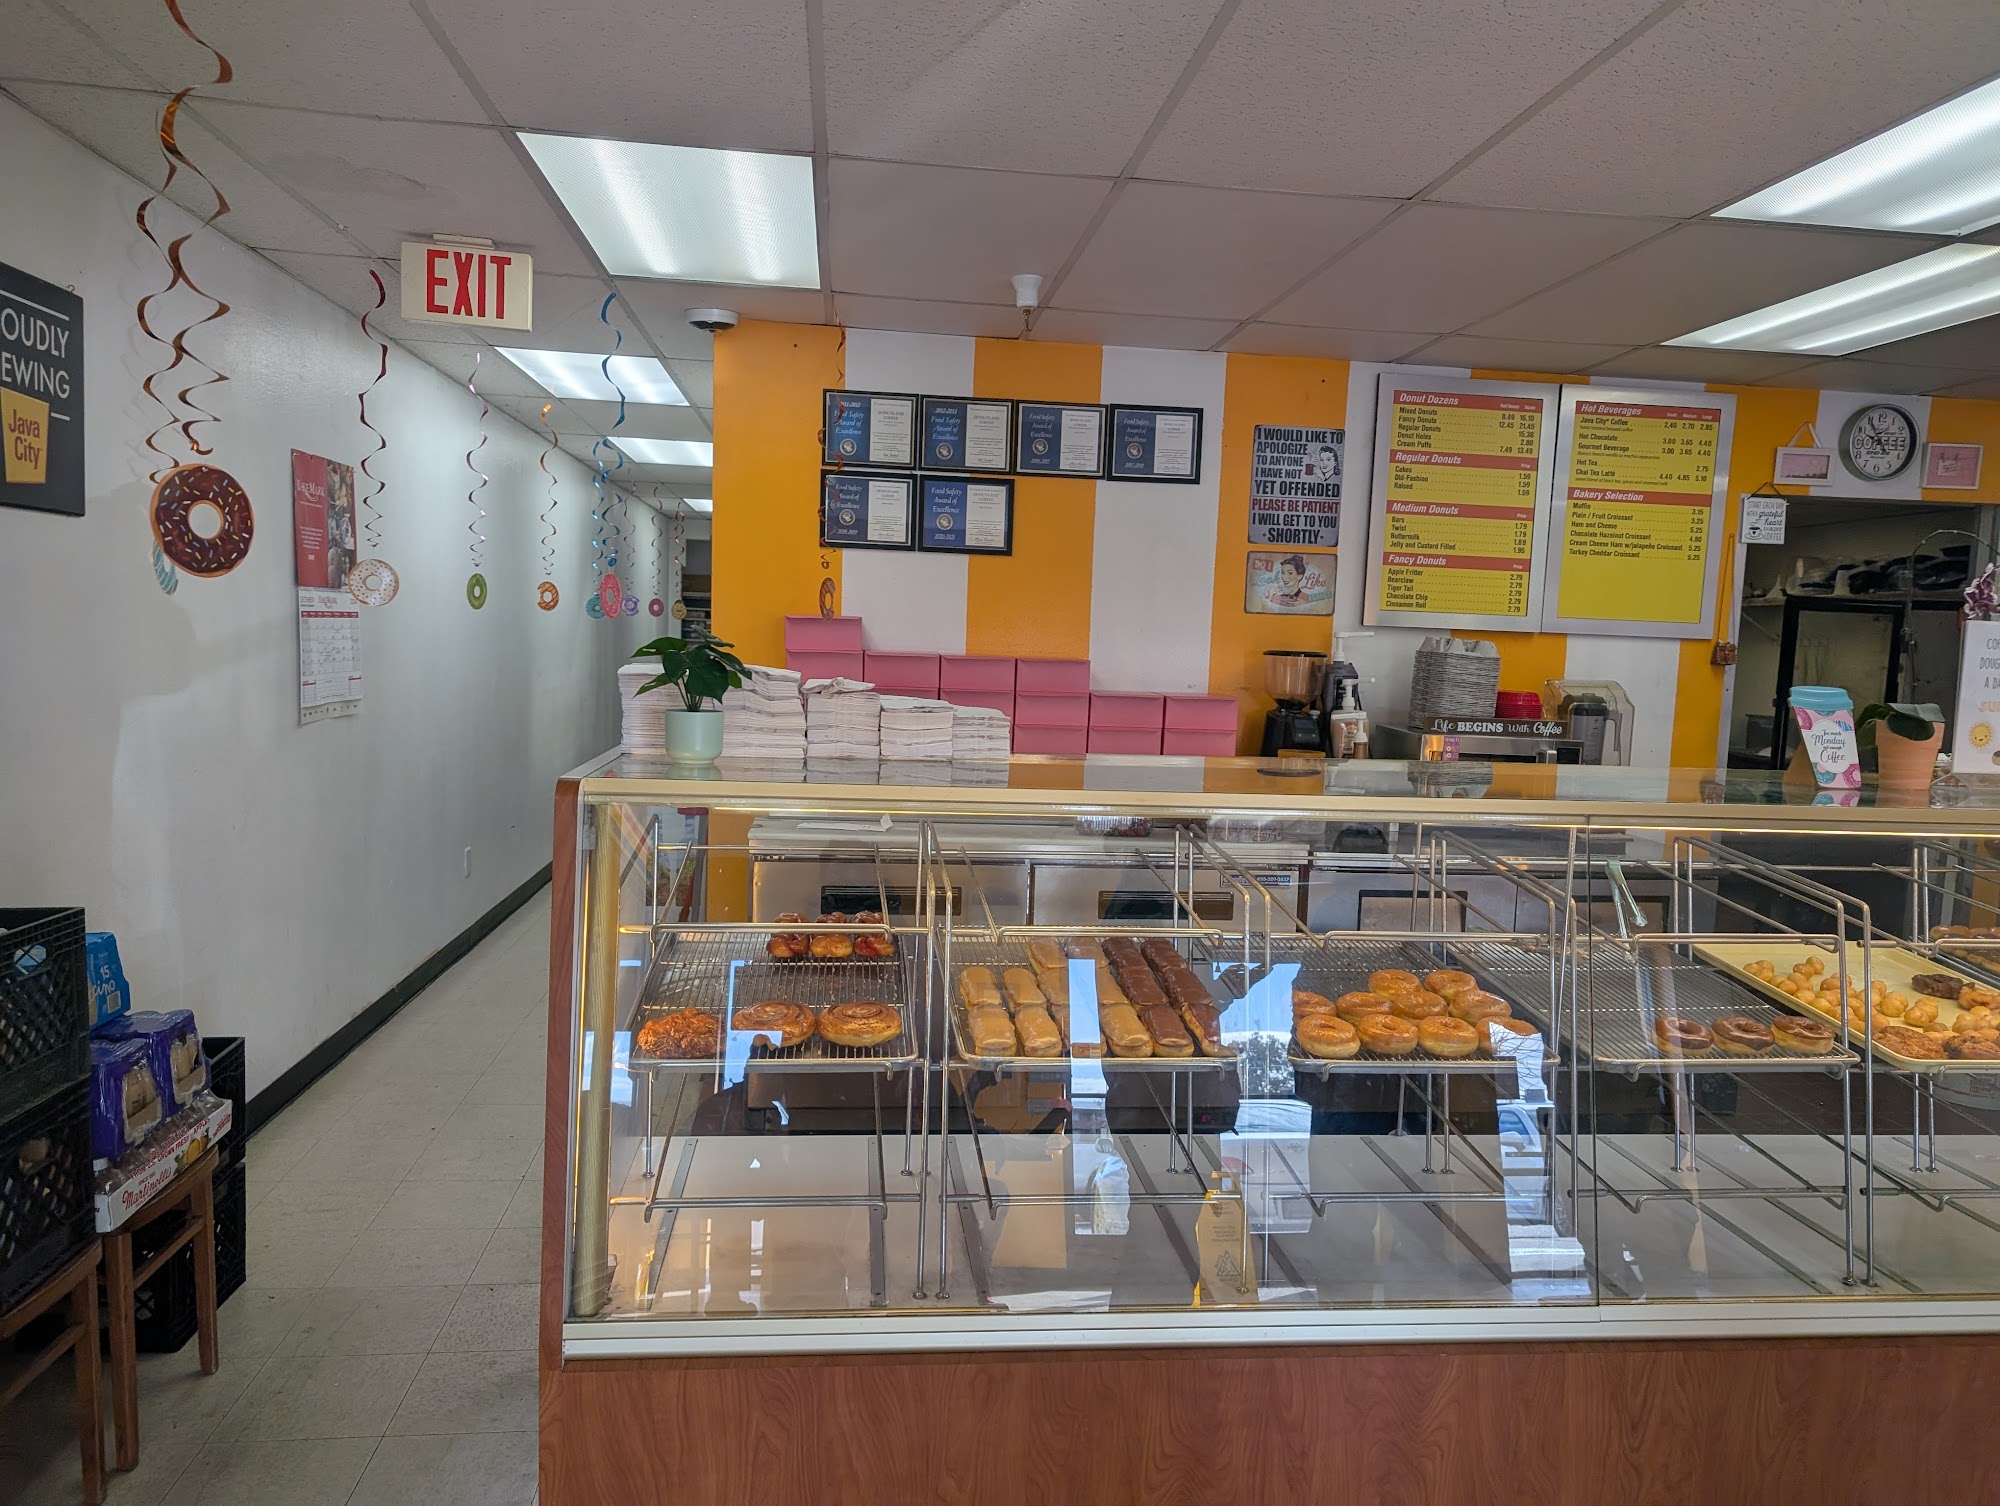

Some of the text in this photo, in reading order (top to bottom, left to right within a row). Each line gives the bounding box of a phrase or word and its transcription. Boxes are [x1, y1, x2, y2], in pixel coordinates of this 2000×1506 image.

[426, 249, 512, 320] EXIT
[1, 308, 69, 358] OUDLY
[2, 352, 70, 398] EWING
[1400, 393, 1459, 405] Donut Dozens
[1399, 407, 1416, 415] Mixed
[1581, 404, 1642, 416] Hot Beverages
[9, 409, 40, 438] Java
[1398, 424, 1420, 432] Regular
[1258, 428, 1343, 444] I WOULD LIKE TO
[1256, 442, 1308, 455] APOLOGIZE
[1604, 444, 1629, 452] Beverage
[1854, 435, 1906, 451] COFFEE
[14, 436, 40, 470] City
[1396, 452, 1462, 464] Regular Donuts
[1256, 455, 1304, 467] TO ANYONE
[1255, 467, 1302, 479] I HAVE NOT
[1873, 464, 1880, 472] 6
[1394, 474, 1428, 482] Old-Fashion
[1255, 480, 1340, 497] YET OFFENDED
[952, 497, 958, 505] of
[1573, 490, 1644, 501] Bakery Selection
[1252, 498, 1340, 514] PLEASE BE PATIENT
[1392, 503, 1459, 515] Medium Donuts
[1252, 513, 1337, 528] I WILL GET TO YOU
[1759, 510, 1784, 519] grateful
[1268, 528, 1320, 544] SHORTLY
[1390, 541, 1404, 550] Jelly
[1569, 548, 1588, 556] Turkey
[1388, 555, 1447, 566] Fancy Donuts
[1388, 568, 1404, 576] Apple
[1301, 573, 1328, 589] Like
[1431, 719, 1562, 736] Life BEGINS With Coffee
[1811, 734, 1846, 747] Monday
[1820, 750, 1846, 763] Coffee
[100, 965, 110, 980] 15
[122, 1166, 172, 1211] Martinelli's
